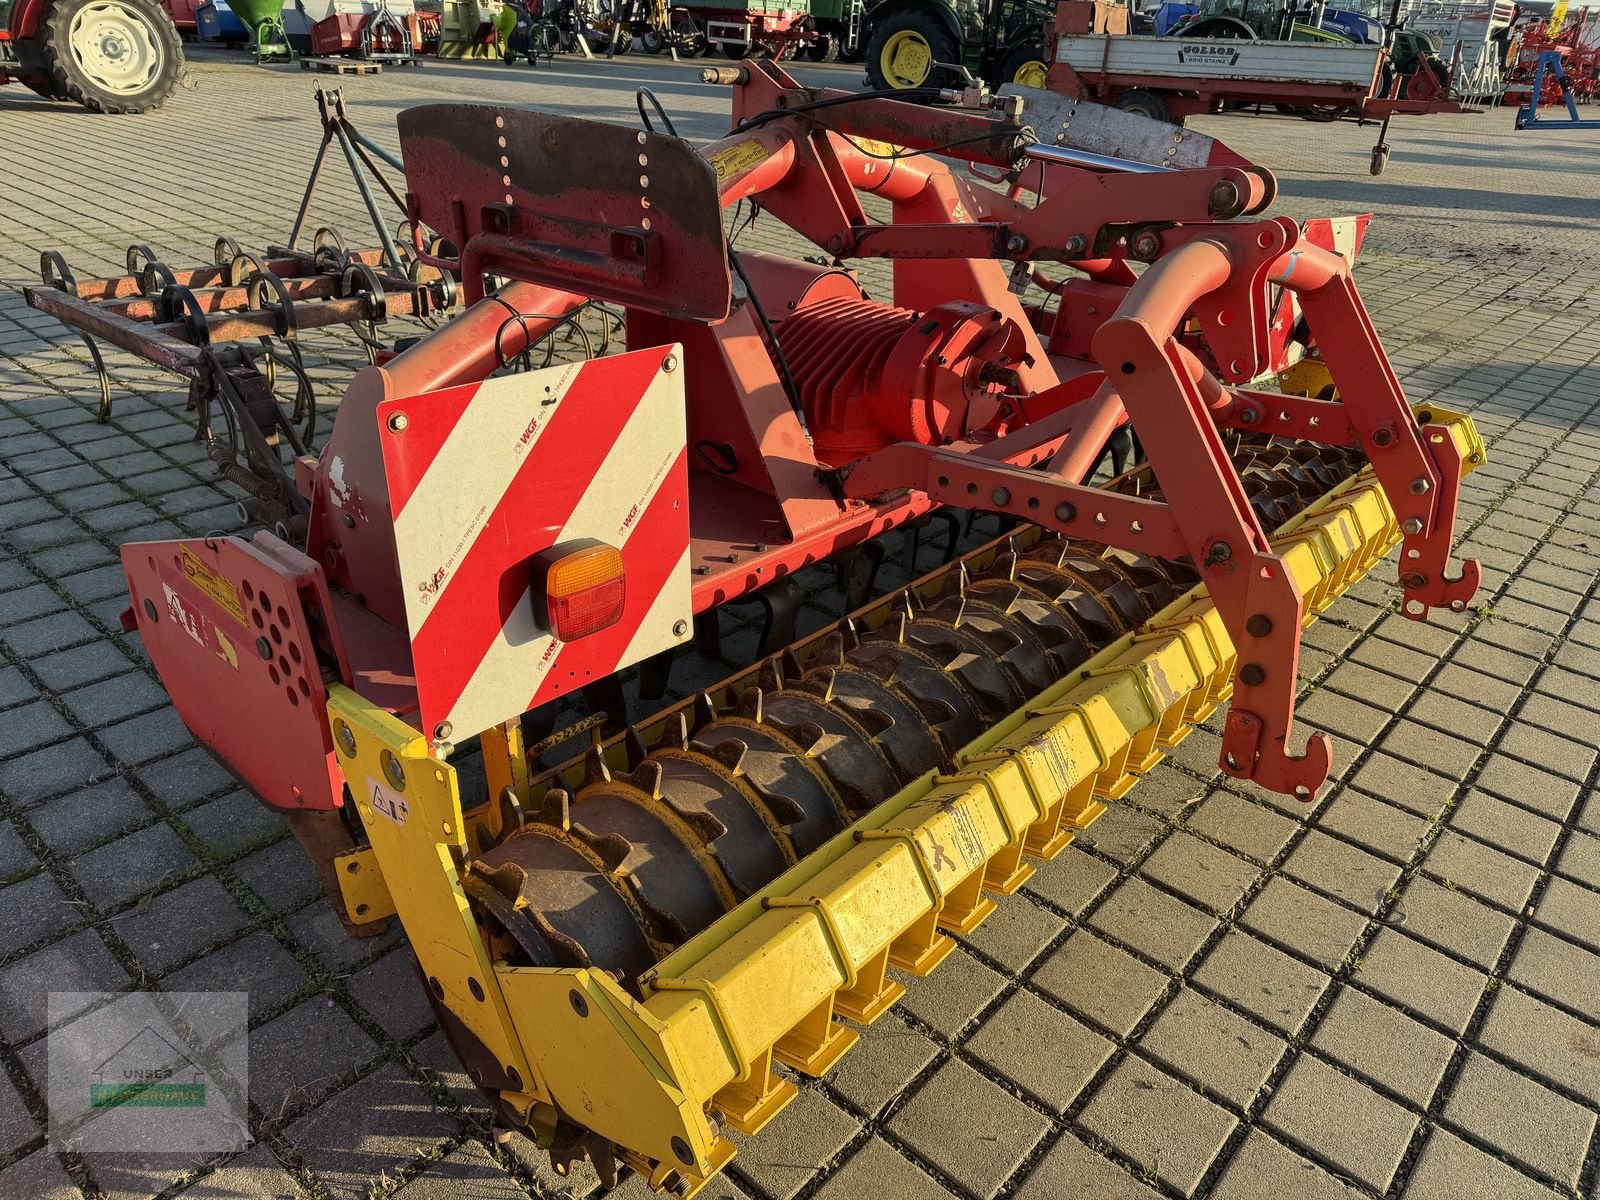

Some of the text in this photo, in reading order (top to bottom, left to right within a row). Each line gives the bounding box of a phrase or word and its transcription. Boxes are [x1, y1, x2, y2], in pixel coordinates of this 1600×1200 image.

[520, 417, 538, 444] WGF
[538, 408, 546, 420] DIN
[623, 503, 639, 527] WGF
